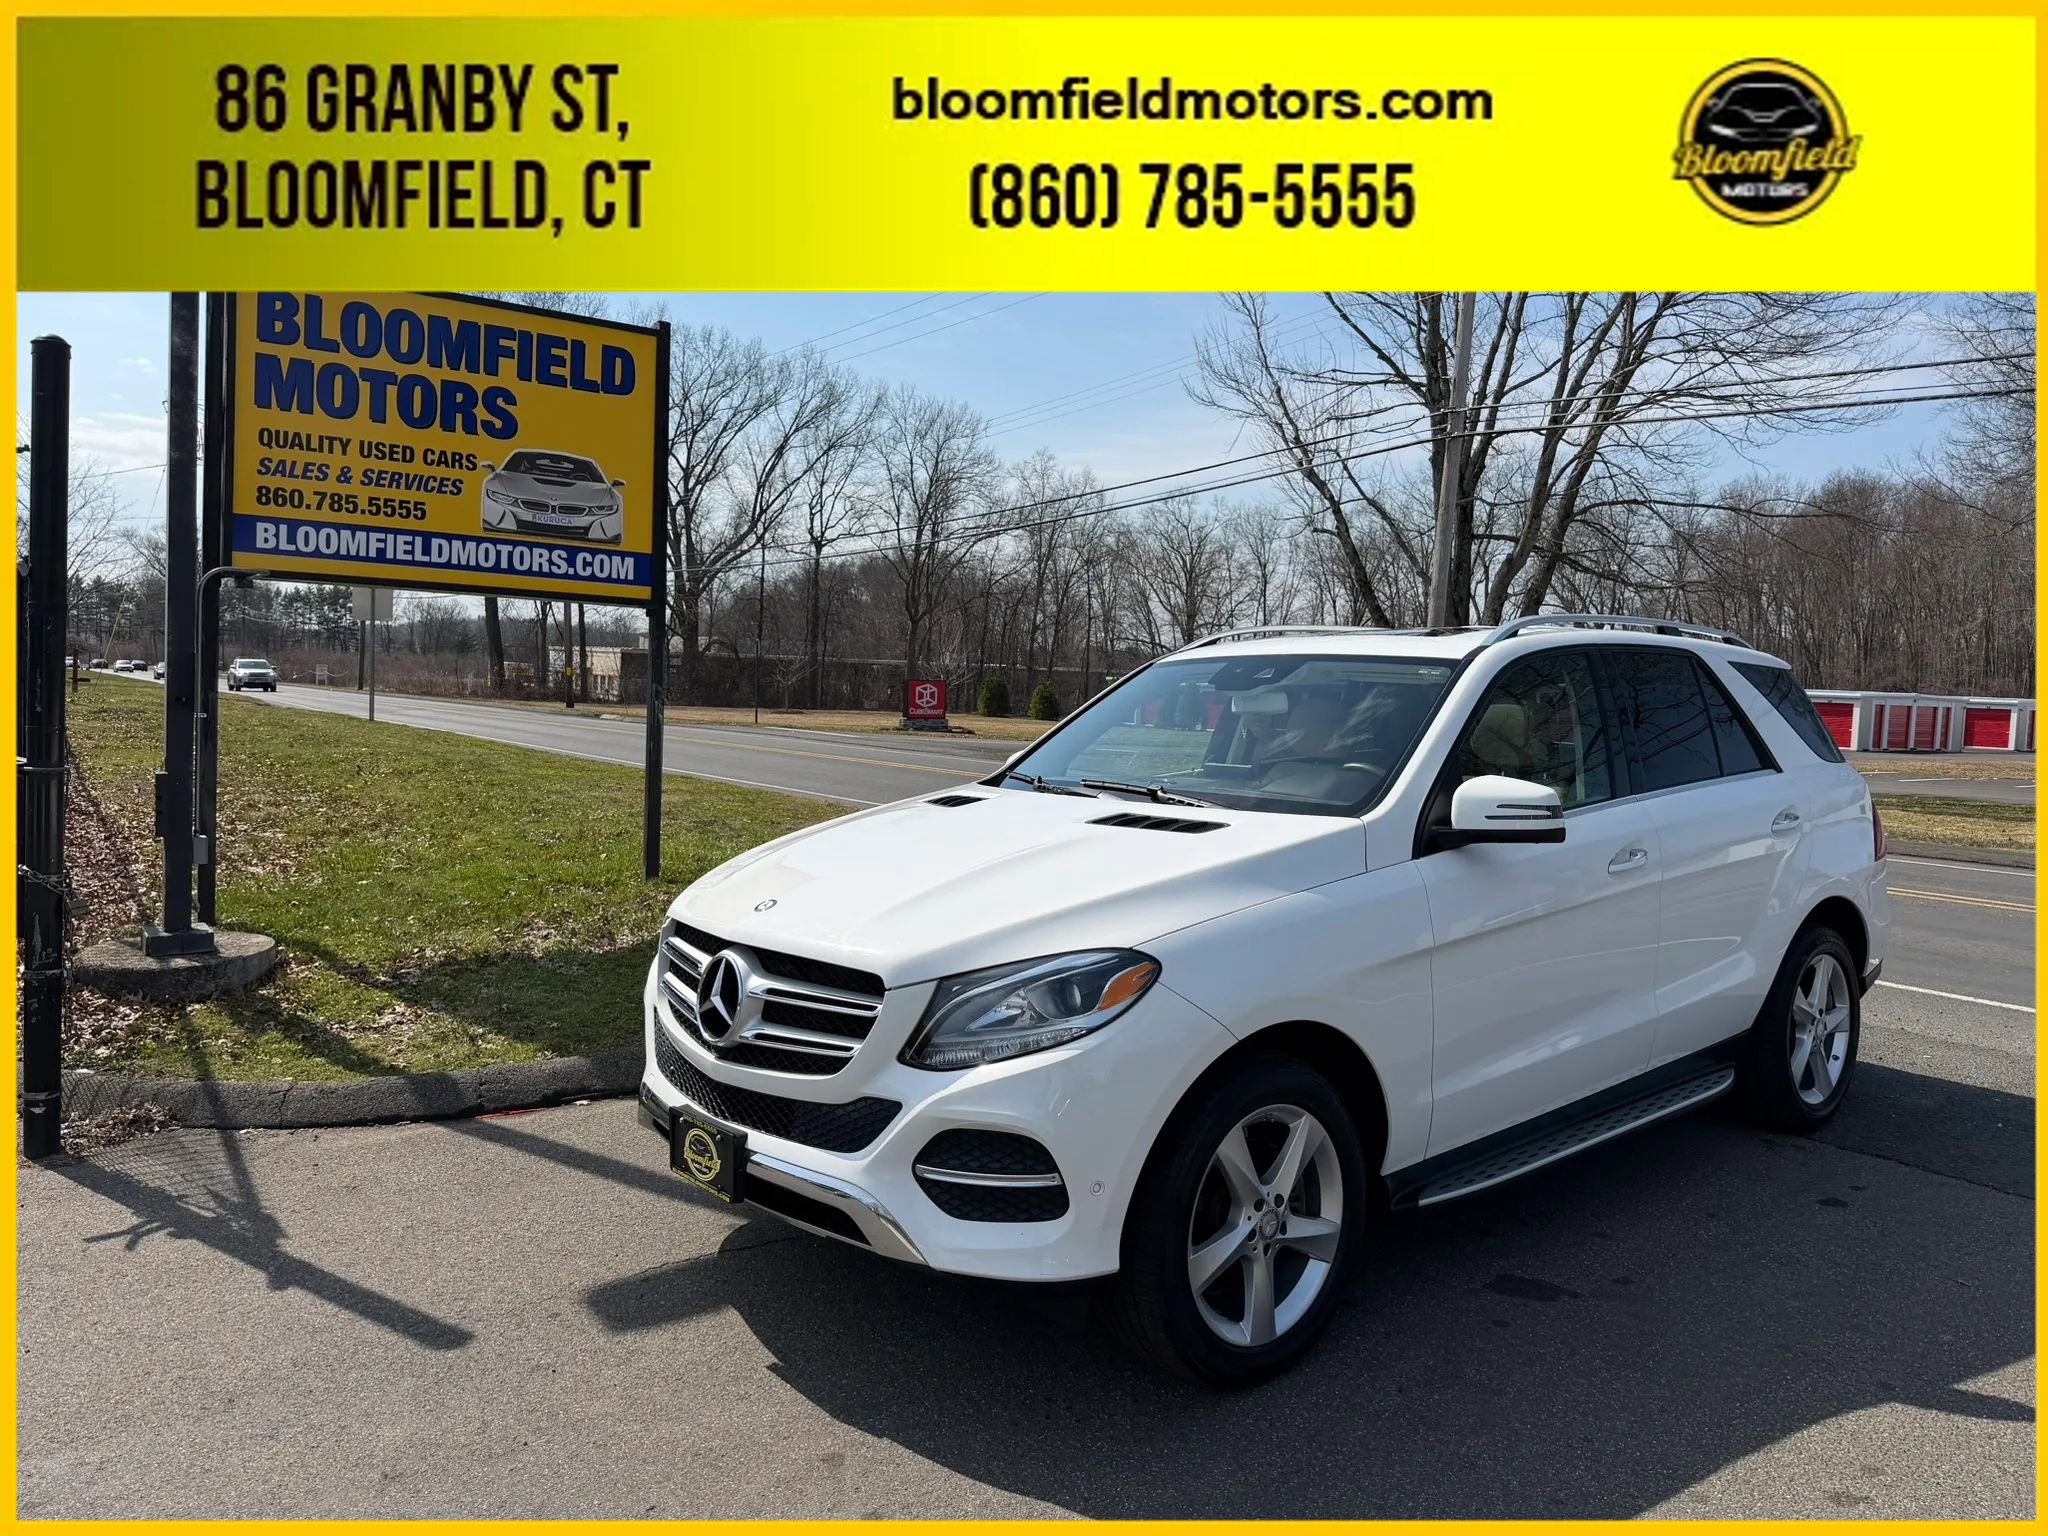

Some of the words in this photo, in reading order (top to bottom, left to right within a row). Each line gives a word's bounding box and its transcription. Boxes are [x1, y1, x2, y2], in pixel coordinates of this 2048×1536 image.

[255, 291, 637, 396] BLOOMFIELD
[254, 351, 519, 440] MOTORS
[258, 427, 352, 456] QUALITY
[359, 440, 416, 465] USED
[422, 447, 478, 471] CARS
[256, 457, 330, 482] SALES
[335, 465, 353, 484] &
[360, 468, 465, 496] SERVICES
[256, 485, 427, 521] 860.785.5555
[255, 522, 635, 581] BLOOMFIELDMOTORS.COM
